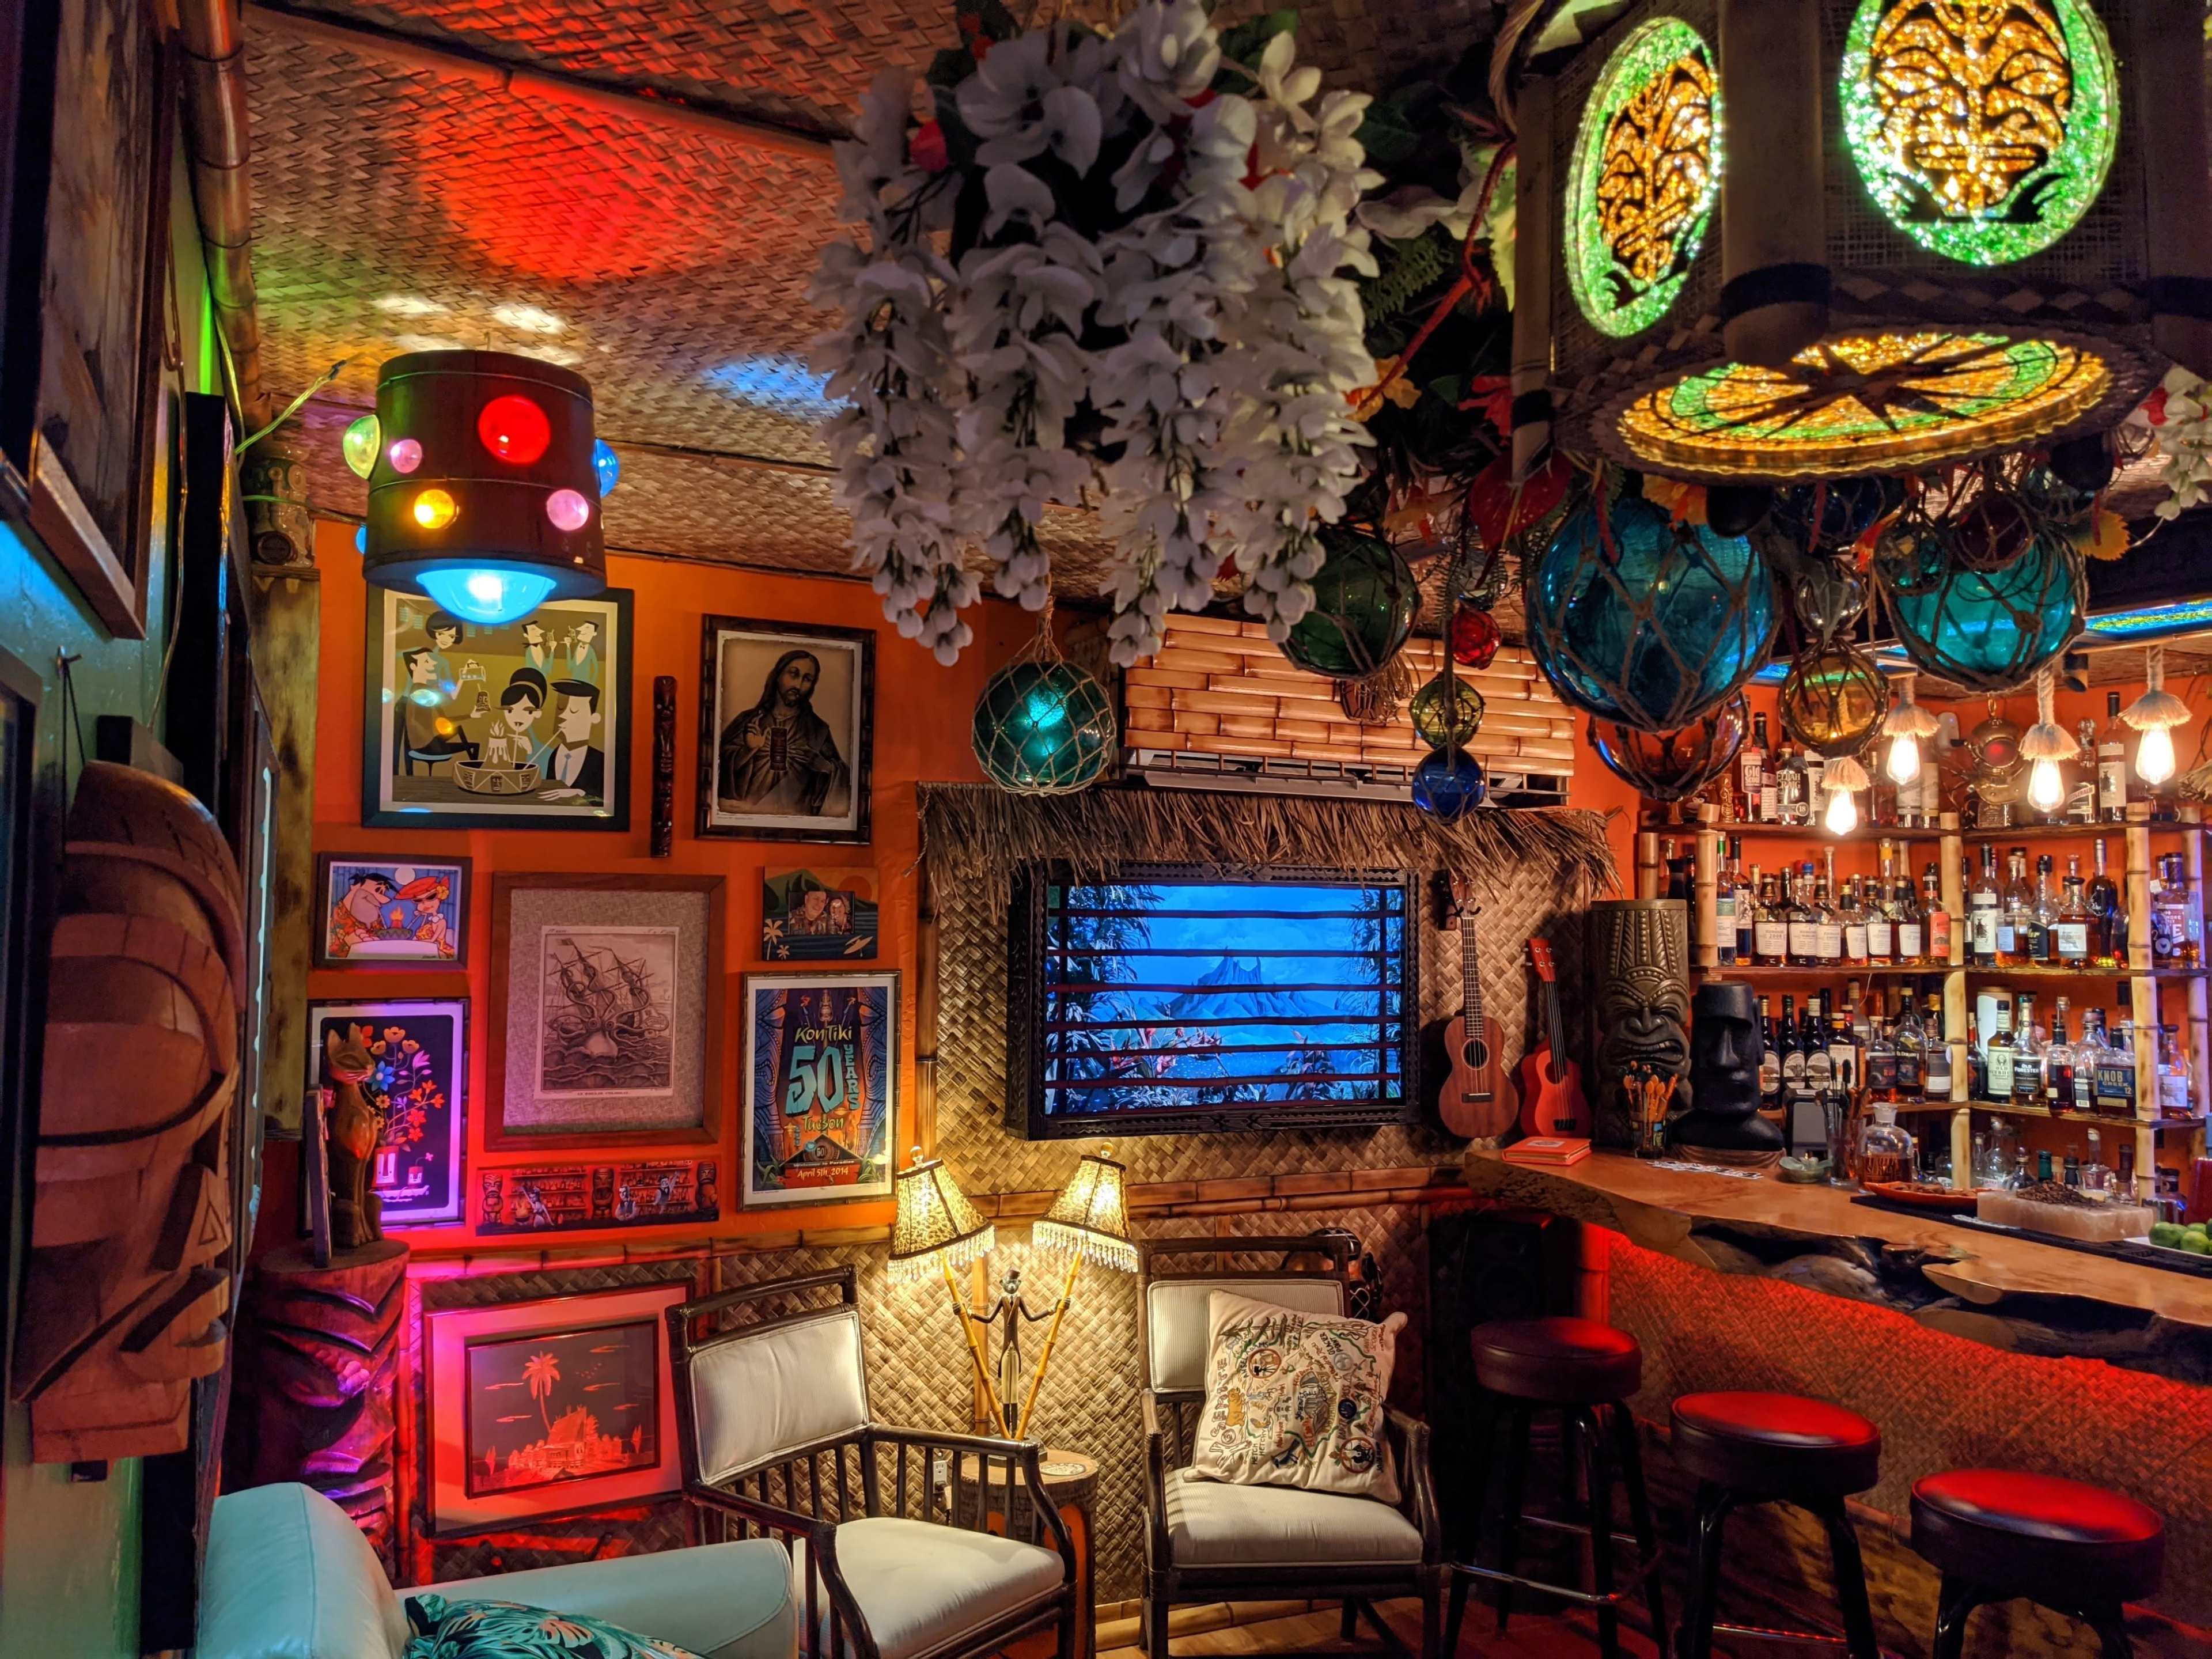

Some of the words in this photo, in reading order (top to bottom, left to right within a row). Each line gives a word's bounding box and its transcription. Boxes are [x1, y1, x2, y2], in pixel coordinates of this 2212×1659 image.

[1777, 773, 1801, 781] ELIJAH
[1777, 781, 1801, 789] CRAIG
[785, 1045, 844, 1115] 50
[844, 1044, 861, 1109] YEARS
[2098, 1070, 2123, 1082] KNOB
[802, 1115, 844, 1134] Tucson
[816, 1148, 824, 1157] 50
[797, 1168, 815, 1180] April
[831, 1167, 849, 1175] 2014
[1319, 1332, 1336, 1355] GLACIER
[1331, 1336, 1343, 1352] POINT
[1240, 1356, 1249, 1378] ANSEL
[1317, 1371, 1337, 1398] VALLEY
[1258, 1429, 1267, 1456] HETCHY
